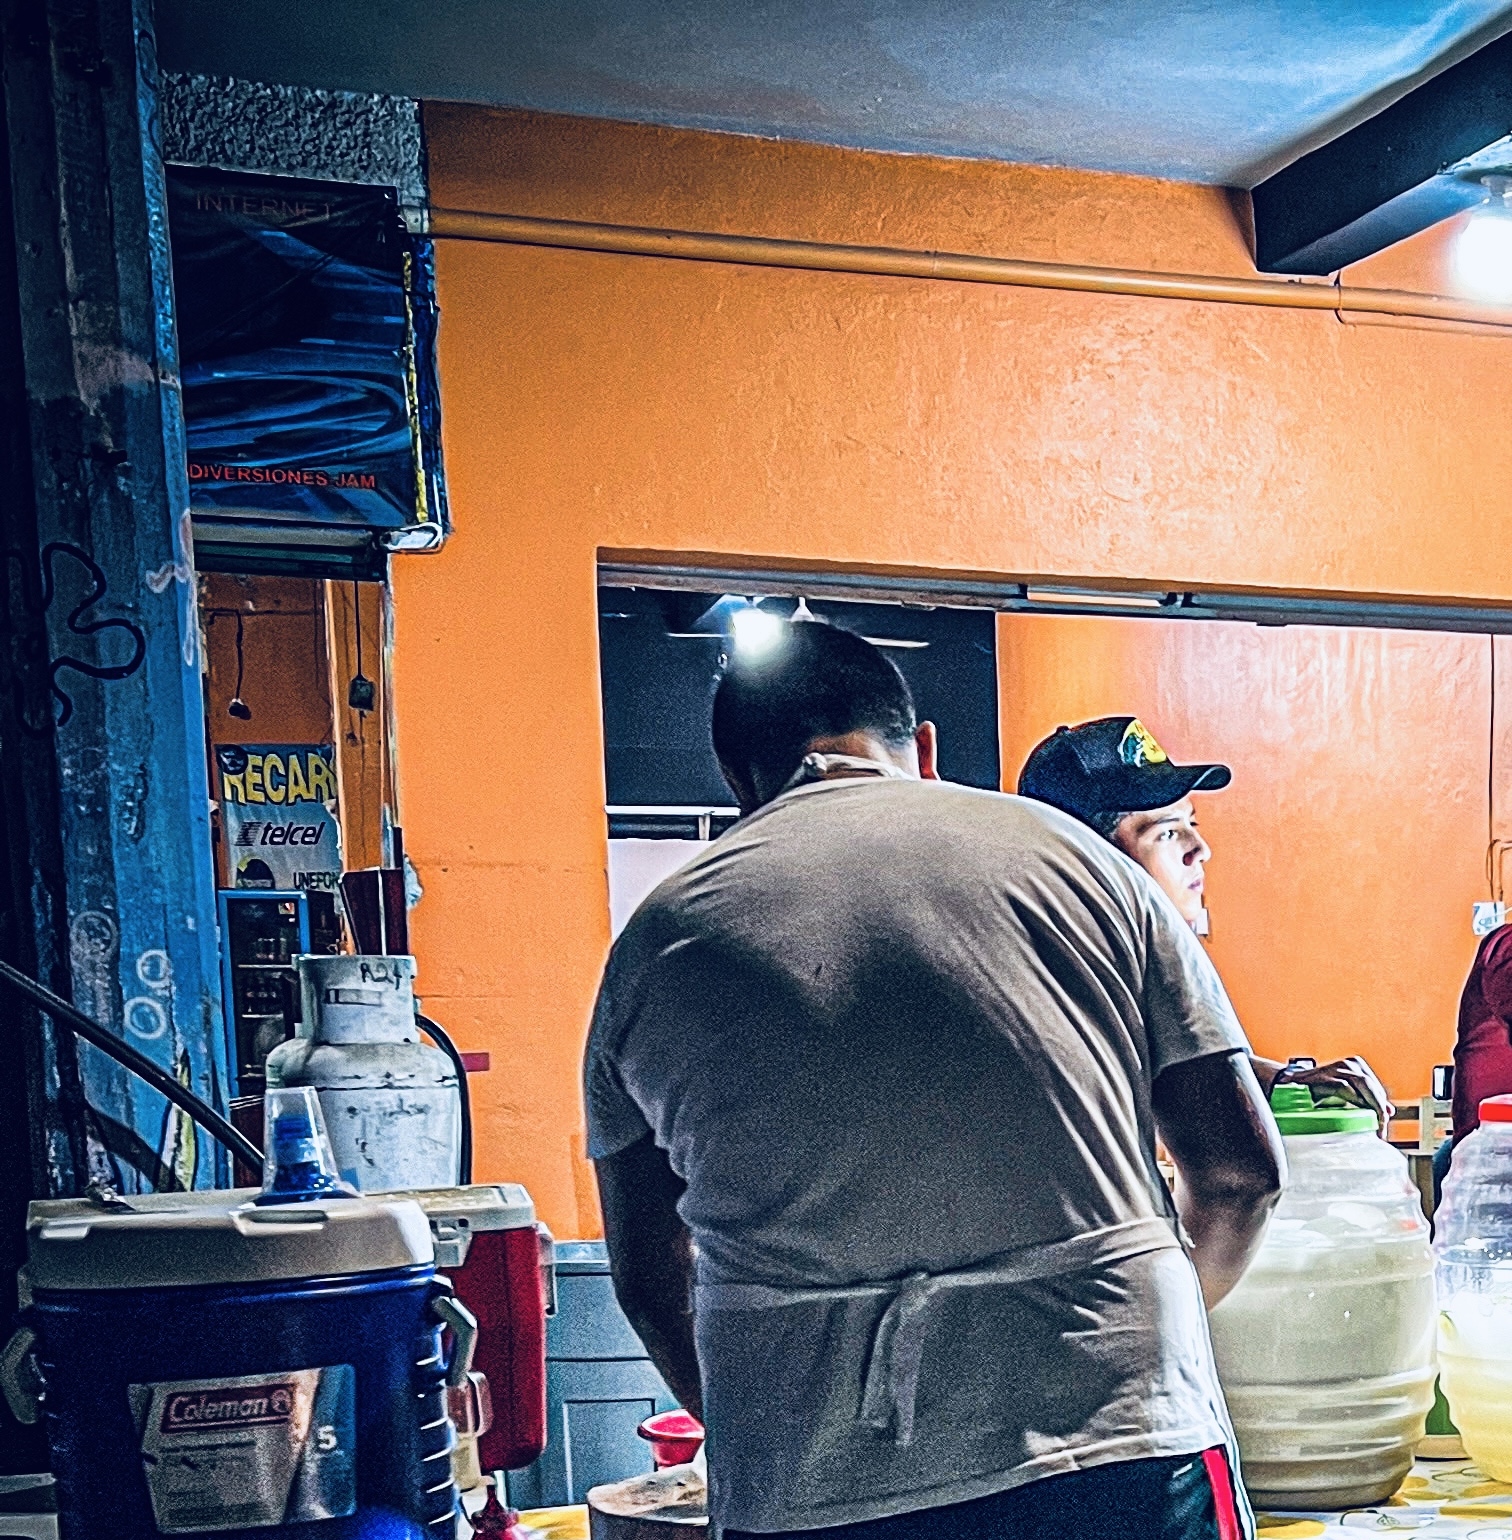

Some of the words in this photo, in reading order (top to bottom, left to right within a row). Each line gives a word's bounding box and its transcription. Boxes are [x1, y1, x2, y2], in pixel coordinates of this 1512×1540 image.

[196, 193, 332, 219] INTERNET
[189, 463, 328, 487] DIVERSIONES
[334, 473, 376, 489] JAM
[222, 751, 337, 804] RECAR
[260, 821, 326, 846] telcel
[168, 1394, 269, 1423] Coleman
